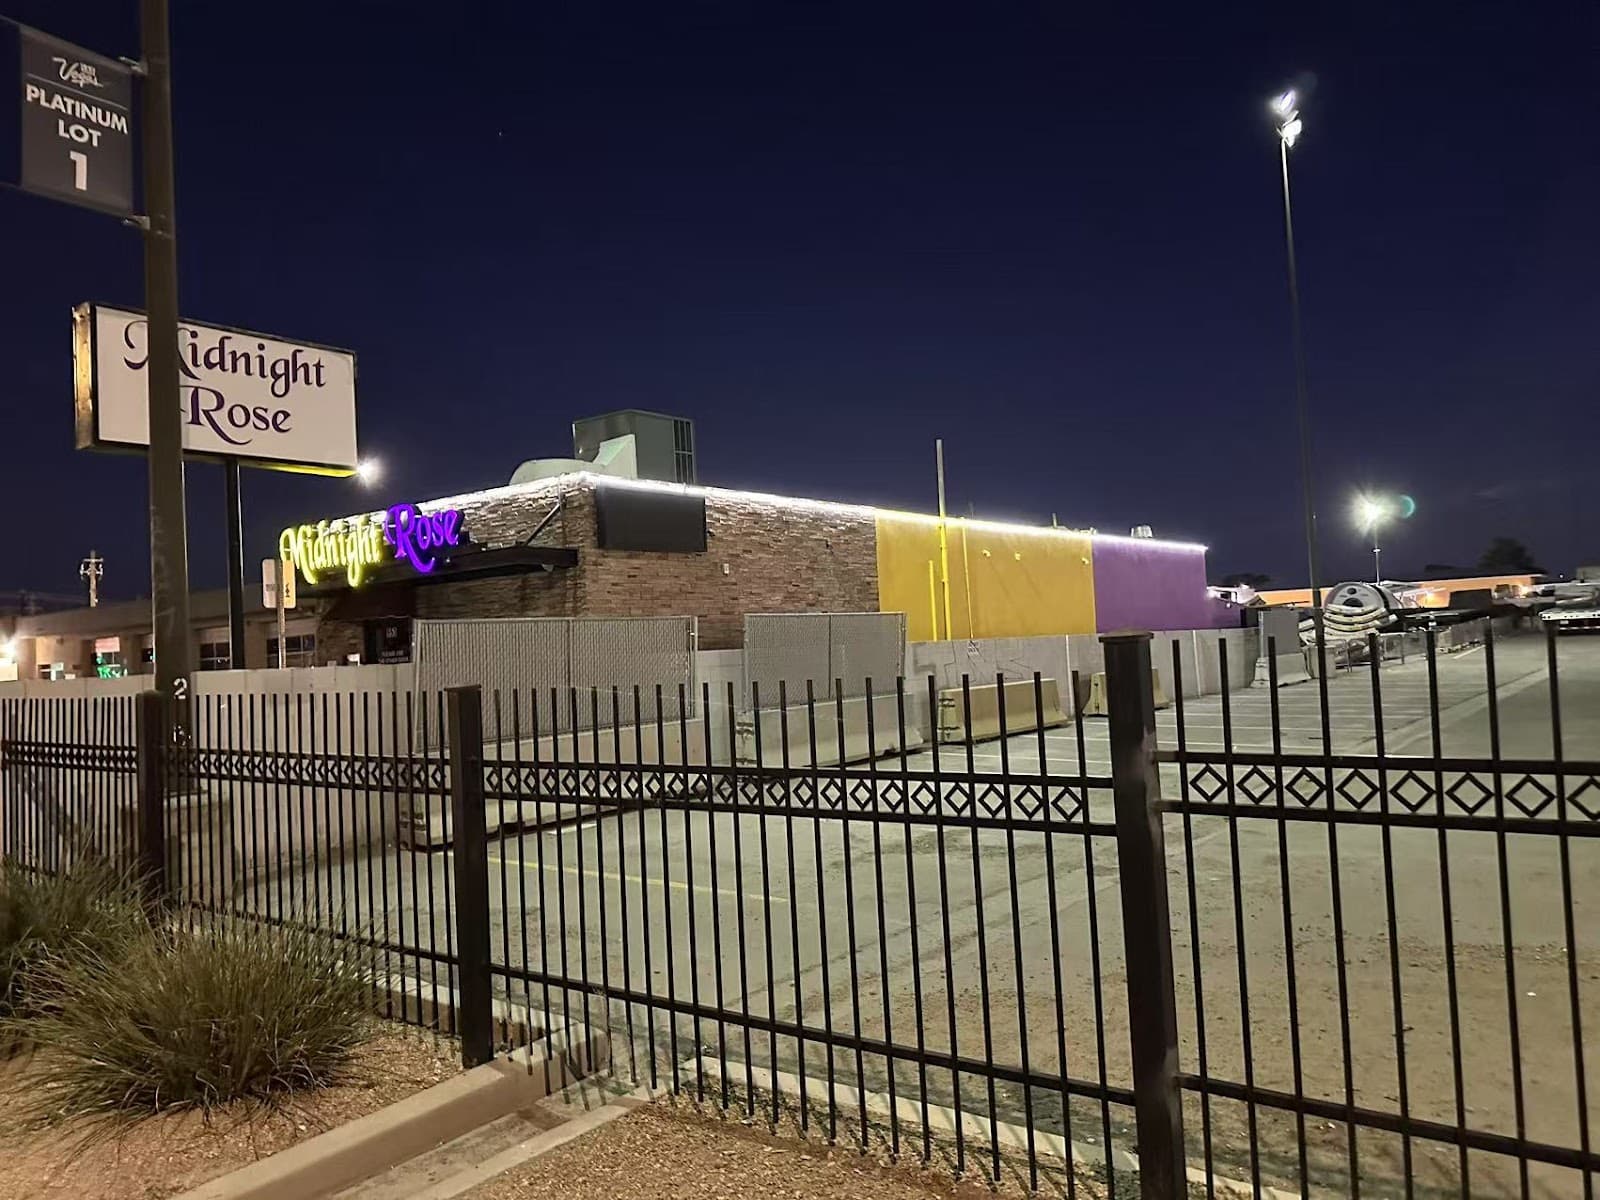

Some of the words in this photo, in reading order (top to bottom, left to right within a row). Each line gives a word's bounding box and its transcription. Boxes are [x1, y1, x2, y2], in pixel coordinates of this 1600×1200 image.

[26, 84, 128, 135] PLATINUM
[58, 119, 101, 147] LOT
[69, 150, 88, 191] 1
[180, 384, 292, 445] Rose
[279, 514, 382, 588] Midnight
[384, 503, 463, 573] Rose
[173, 678, 188, 699] 2
